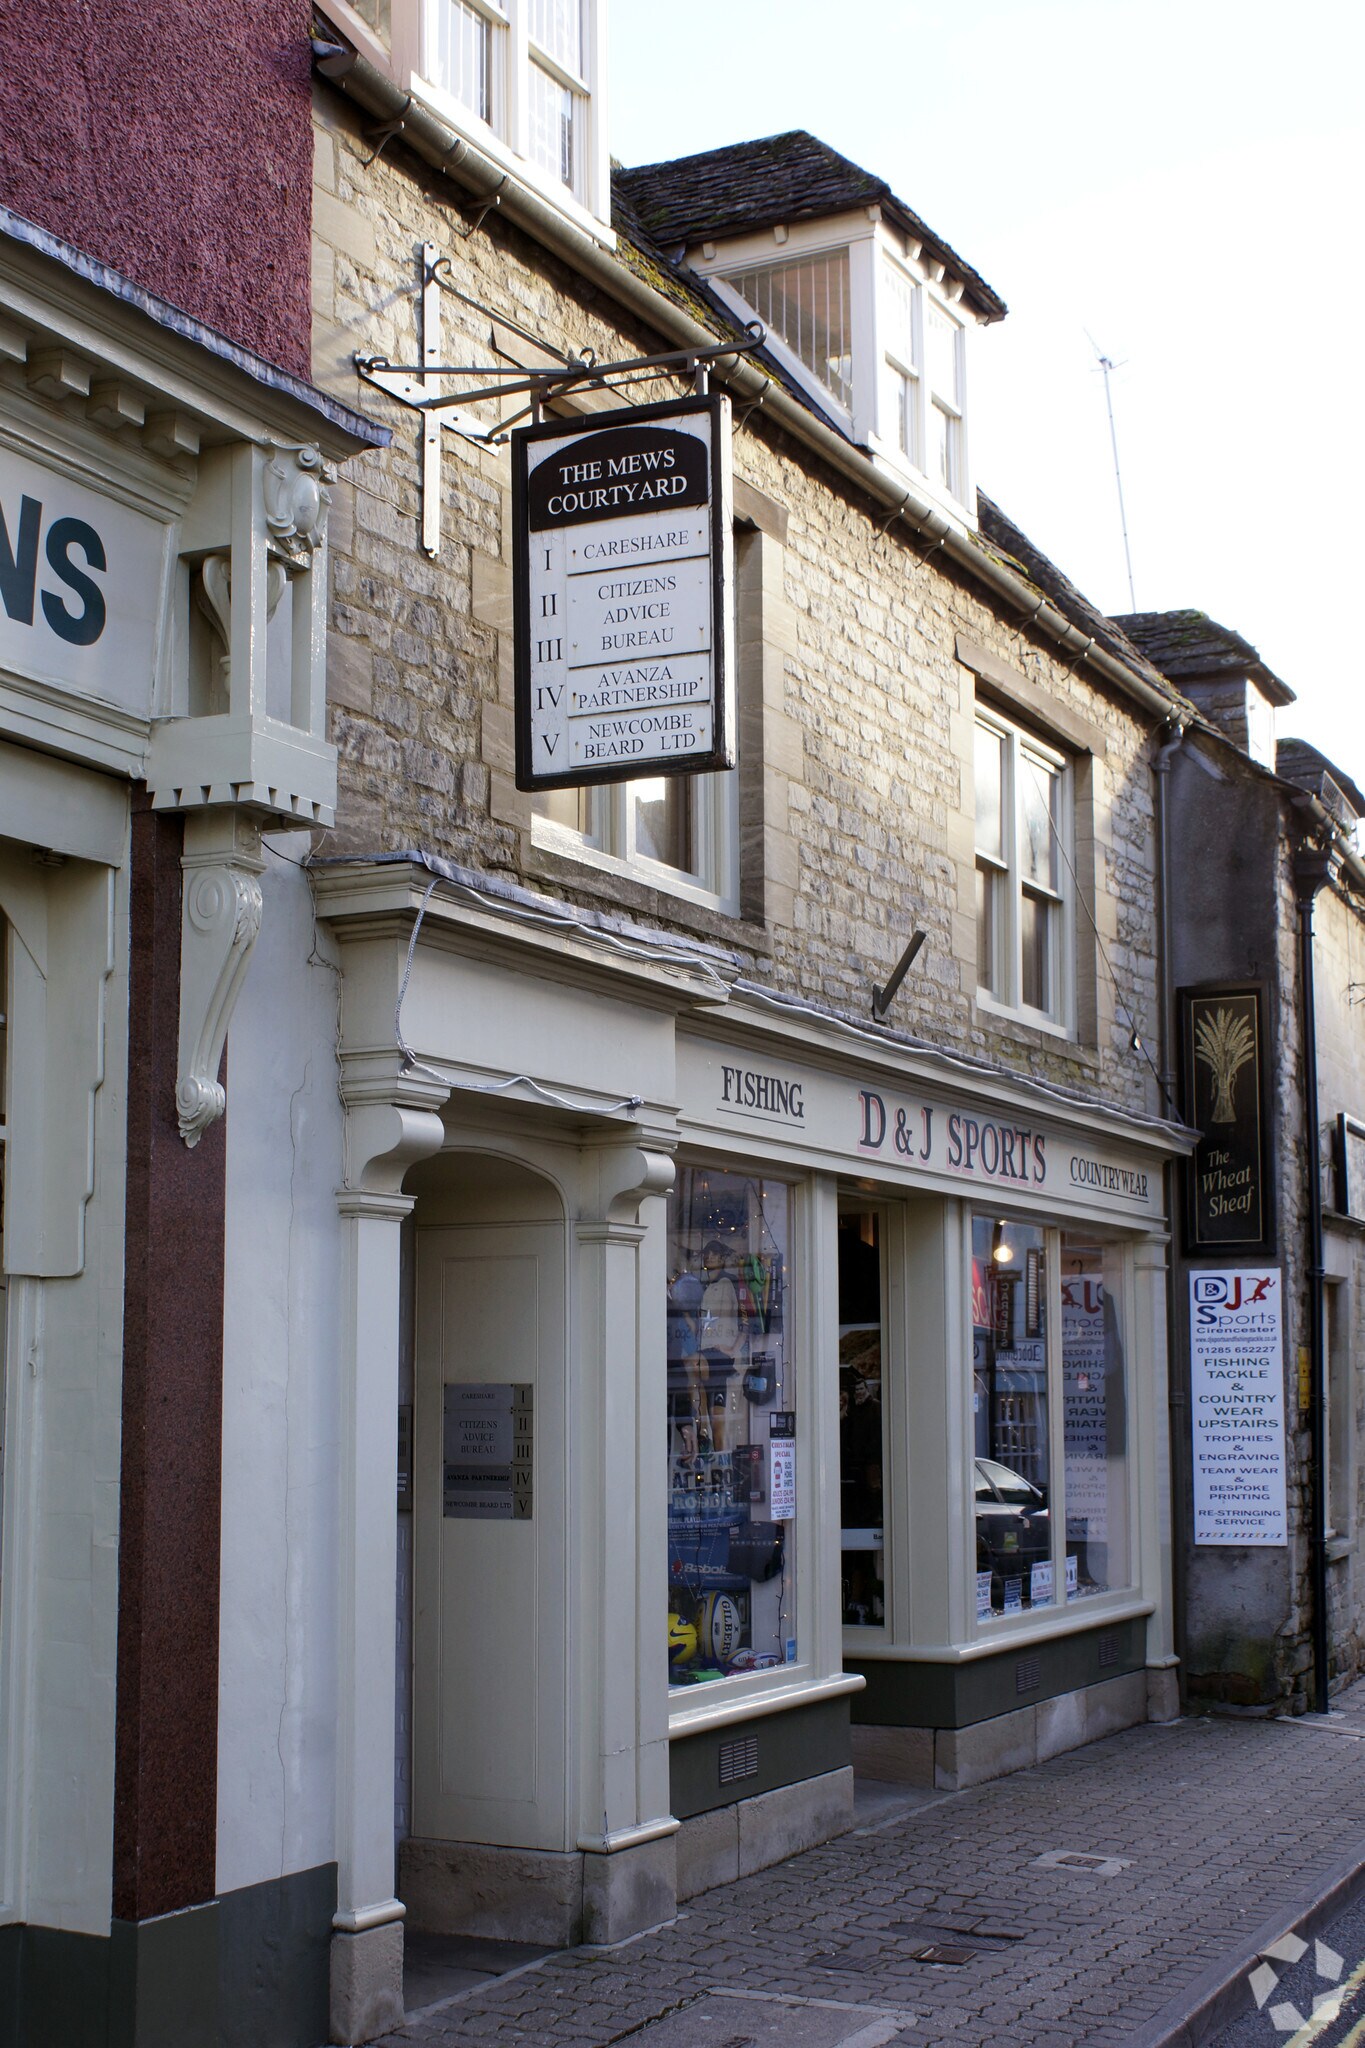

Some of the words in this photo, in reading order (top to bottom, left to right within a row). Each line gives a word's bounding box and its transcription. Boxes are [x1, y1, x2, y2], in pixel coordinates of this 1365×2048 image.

[560, 460, 602, 486] THE
[608, 448, 676, 477] MEWS
[547, 475, 688, 515] COURTYARD
[583, 529, 690, 560] CARESHARE
[544, 548, 552, 571] I
[598, 576, 677, 601] CITIZENS
[540, 594, 558, 617] II
[603, 602, 671, 625] ADVICE
[536, 638, 563, 663] III
[601, 627, 675, 651] BUREAU
[598, 666, 673, 688] AVANZA
[536, 686, 565, 711] IV
[578, 681, 700, 709] PARTNERSHIP
[589, 714, 693, 740] NEWCOMBE
[540, 734, 561, 757] V
[584, 739, 645, 759] BEARD
[660, 733, 697, 751] LTD
[721, 1065, 805, 1119] FISHING
[858, 1090, 887, 1155] D
[894, 1108, 916, 1159] &
[918, 1106, 935, 1166] J
[946, 1113, 1047, 1189] SPORTS
[1207, 1149, 1230, 1167] The
[1070, 1155, 1149, 1198] COUNTRYWEAR
[1202, 1165, 1251, 1195] Wheat
[1209, 1186, 1255, 1218] Sheaf
[1196, 1305, 1276, 1327] Sports
[1204, 1358, 1270, 1367] FISHING
[1206, 1370, 1268, 1379] TACKLE
[461, 1392, 496, 1400] CARESHARE
[1231, 1383, 1244, 1391] &
[1199, 1395, 1277, 1404] COUNTRY
[1213, 1407, 1264, 1416] WEAR
[459, 1420, 498, 1429] CITIZENS
[519, 1417, 527, 1431] II
[1198, 1419, 1279, 1428] UPSTAIRS
[462, 1433, 494, 1441] ADVICE
[461, 1446, 496, 1454] BUREAU
[517, 1445, 530, 1458] III
[516, 1472, 530, 1485] IV
[519, 1500, 528, 1513] V
[722, 1600, 733, 1657] GILBERT
